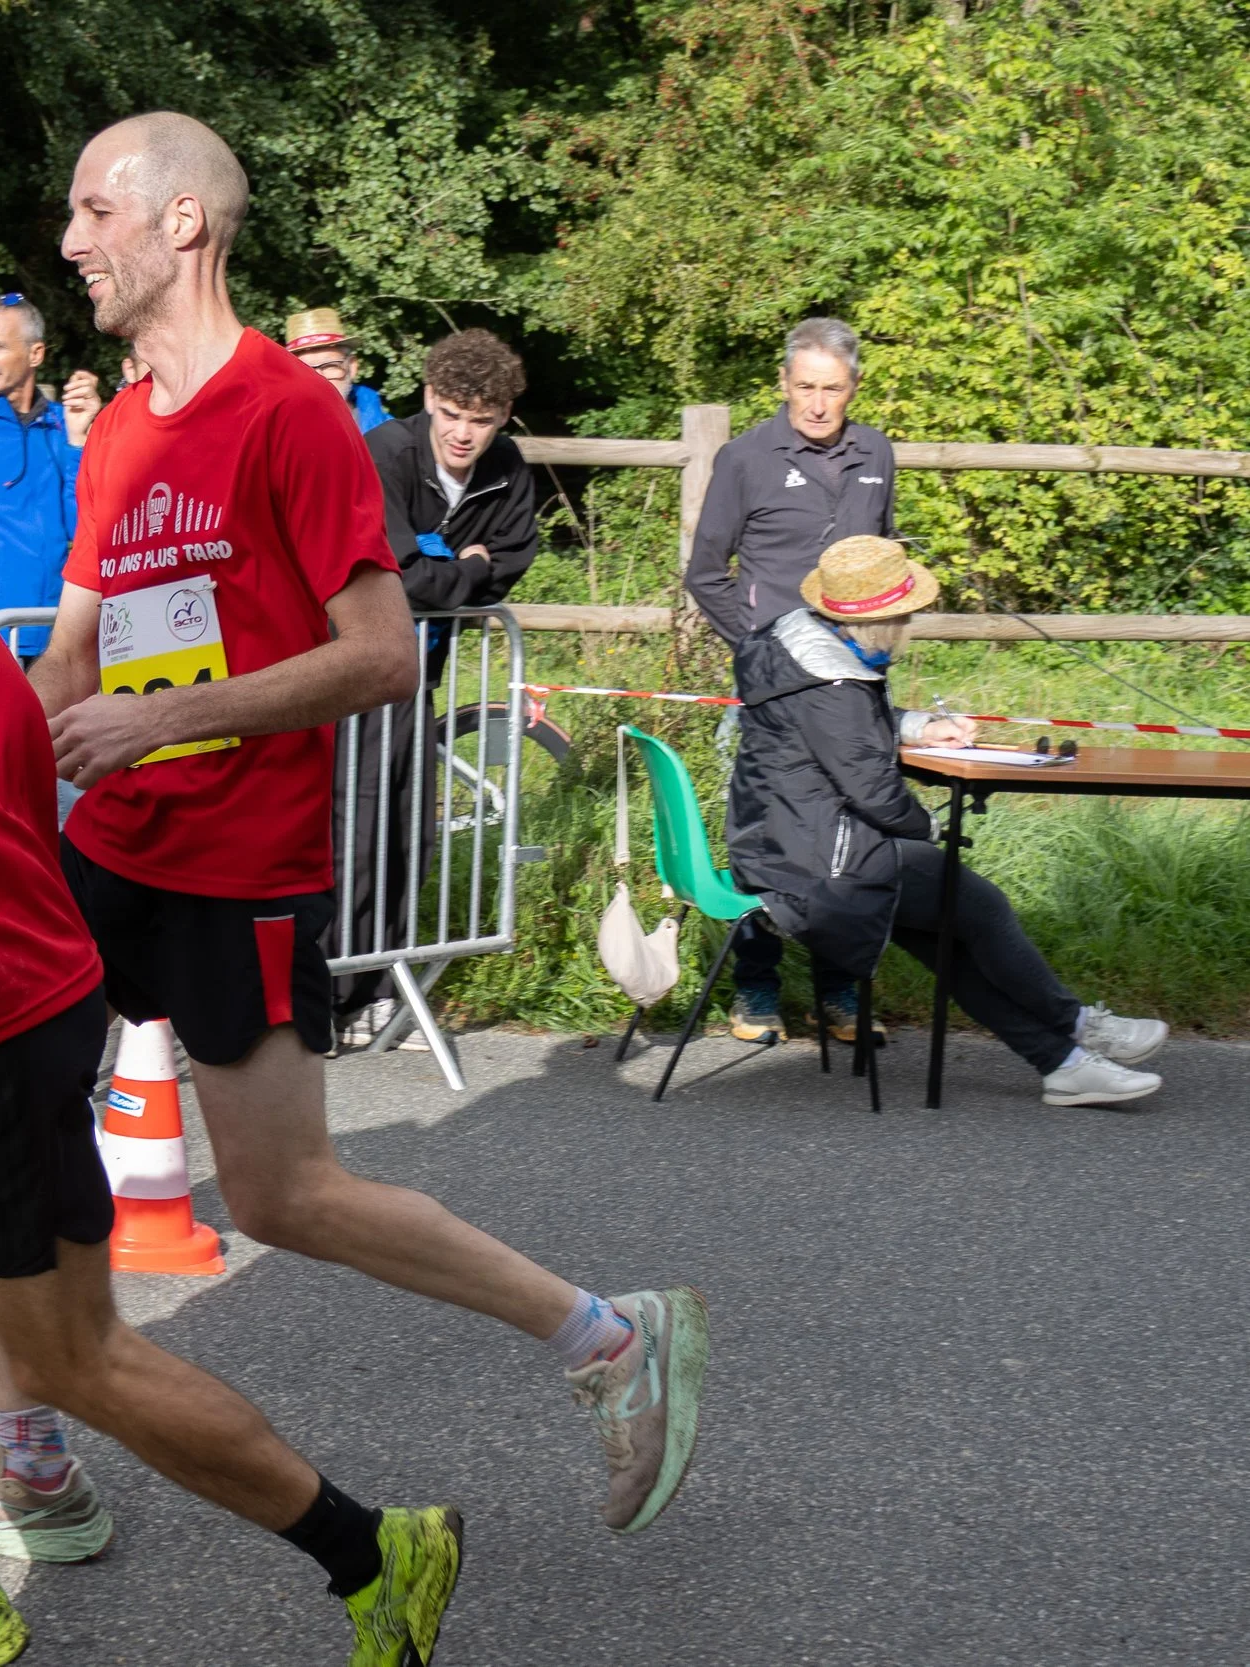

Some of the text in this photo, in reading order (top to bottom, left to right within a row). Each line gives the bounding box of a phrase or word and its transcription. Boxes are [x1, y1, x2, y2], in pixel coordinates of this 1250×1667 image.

[100, 540, 233, 578] 10 ANS PLUS TARD
